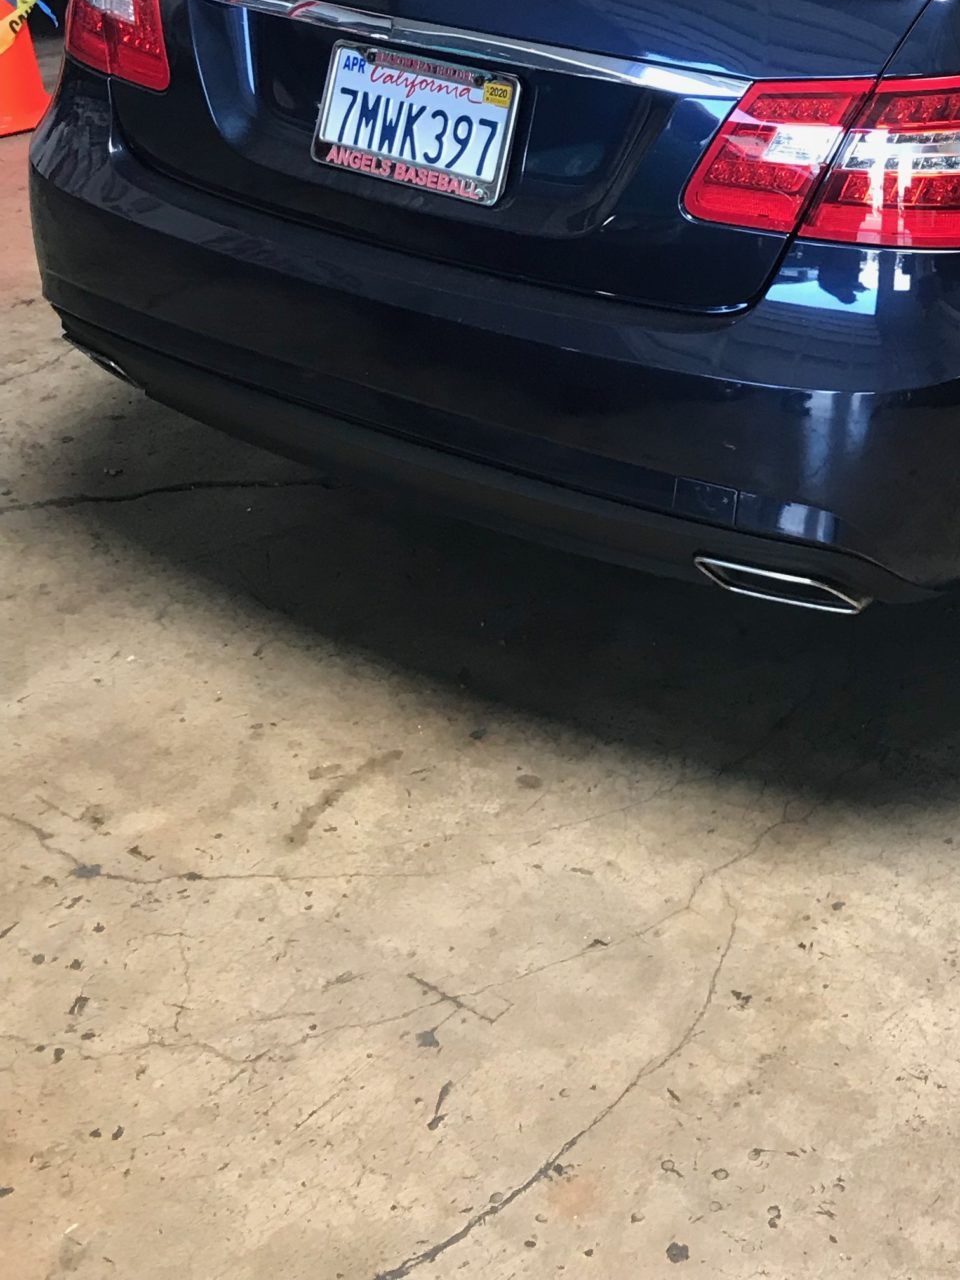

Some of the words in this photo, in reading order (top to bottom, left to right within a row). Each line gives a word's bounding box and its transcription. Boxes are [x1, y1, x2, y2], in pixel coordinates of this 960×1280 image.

[343, 55, 366, 74] APR
[370, 65, 483, 104] California
[489, 86, 508, 99] 2020
[338, 87, 498, 176] 7MWK397
[326, 145, 392, 178] ANGELS
[394, 162, 481, 200] BASEBALL
